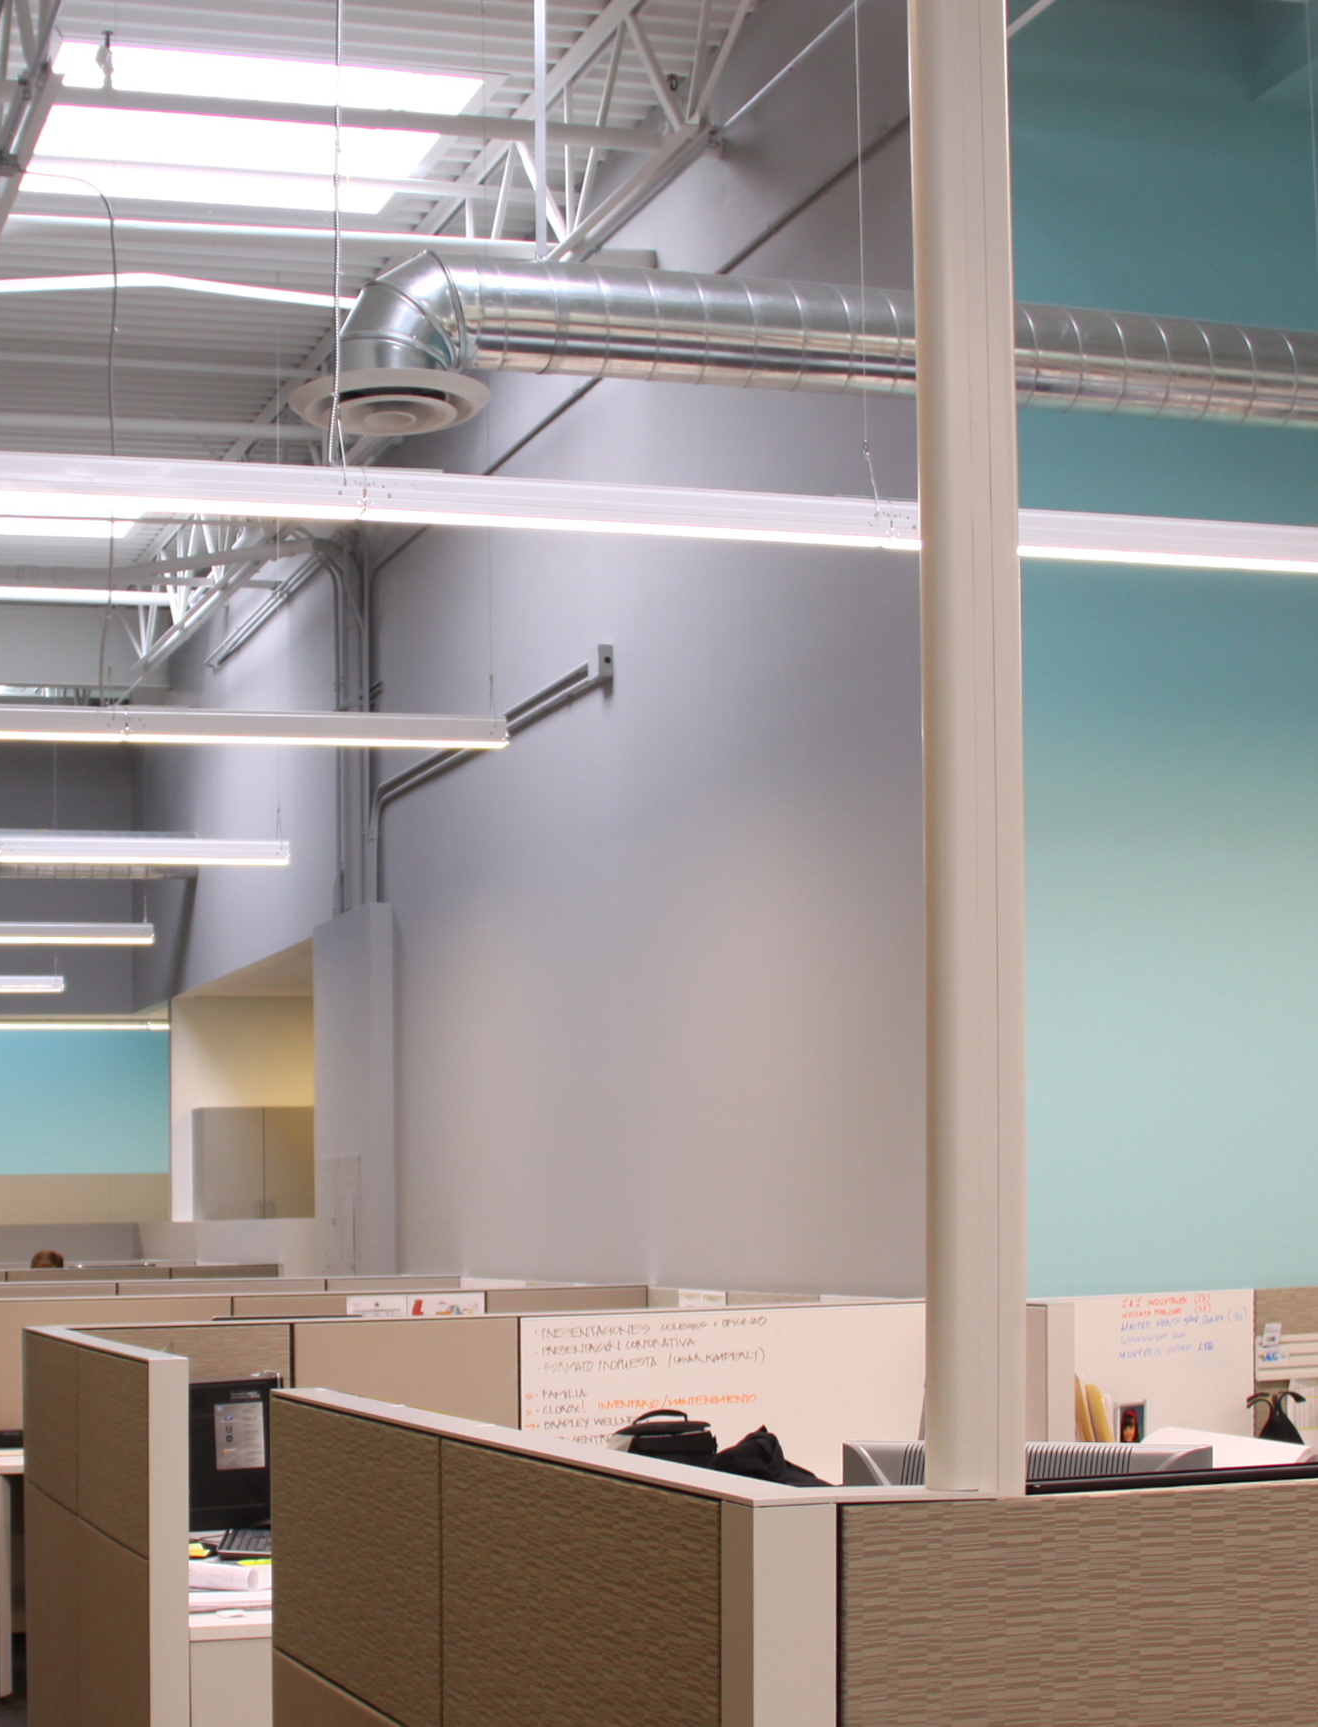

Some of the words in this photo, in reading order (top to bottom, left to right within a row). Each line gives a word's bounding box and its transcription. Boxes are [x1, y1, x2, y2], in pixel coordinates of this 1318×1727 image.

[543, 1360, 593, 1375] FORMATO
[542, 1388, 588, 1400] FAMILIA
[543, 1417, 589, 1430] BRADLEY
